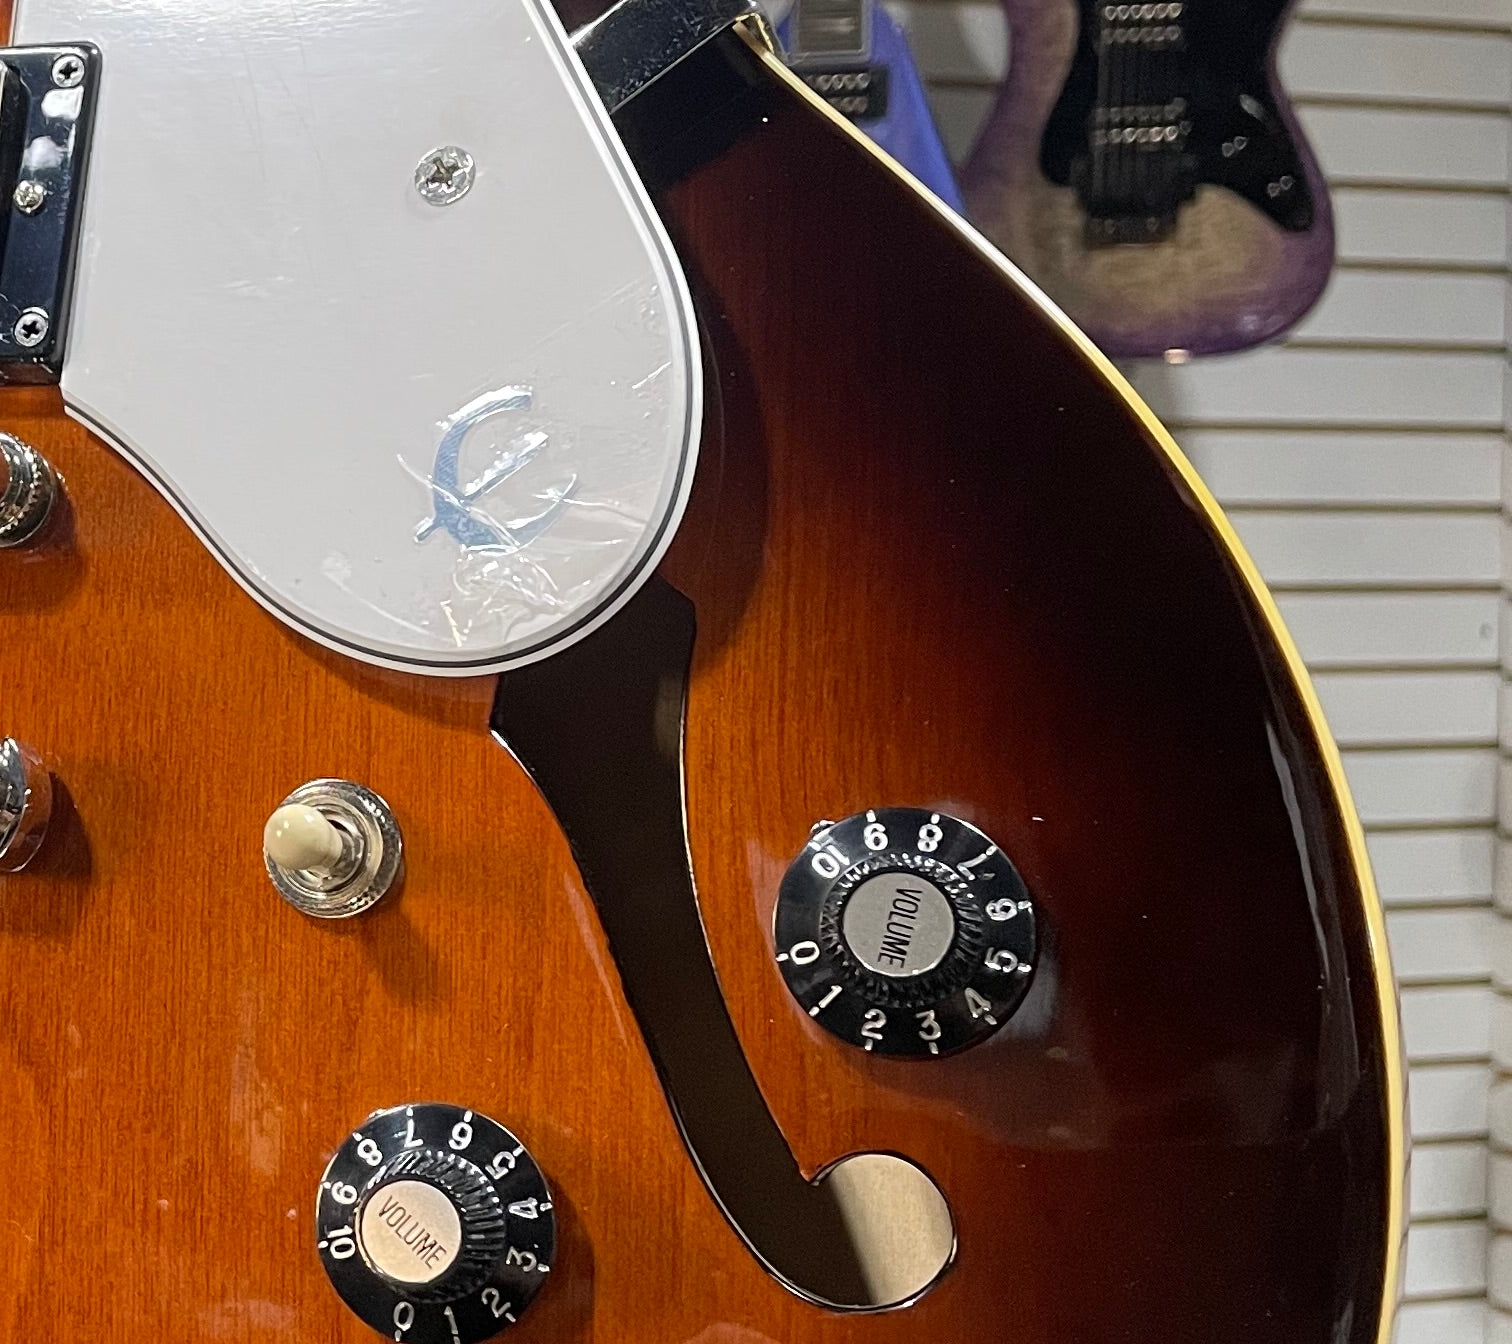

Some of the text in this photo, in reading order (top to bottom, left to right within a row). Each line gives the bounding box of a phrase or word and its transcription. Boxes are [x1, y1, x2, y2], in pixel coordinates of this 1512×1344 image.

[863, 823, 888, 850] 9
[918, 823, 943, 852] 8
[811, 844, 850, 879] 10
[957, 854, 986, 881] 7
[986, 898, 1018, 921] 6
[877, 888, 922, 968] VOLUME
[790, 941, 820, 965] 0
[985, 948, 1018, 972] 5
[819, 985, 842, 1008] 1
[965, 988, 991, 1018] 4
[861, 1009, 886, 1040] 2
[916, 1010, 941, 1040] 3
[404, 1119, 423, 1147] 7
[449, 1122, 472, 1150] 6
[357, 1139, 383, 1166] 8
[486, 1152, 516, 1180] 5
[331, 1181, 358, 1205] 9
[509, 1197, 538, 1219] 4
[328, 1225, 355, 1259] 10
[379, 1195, 447, 1269] VOLUME
[506, 1246, 536, 1272] 3
[393, 1301, 414, 1331] 0
[481, 1288, 511, 1317] 2
[444, 1306, 458, 1334] 1
